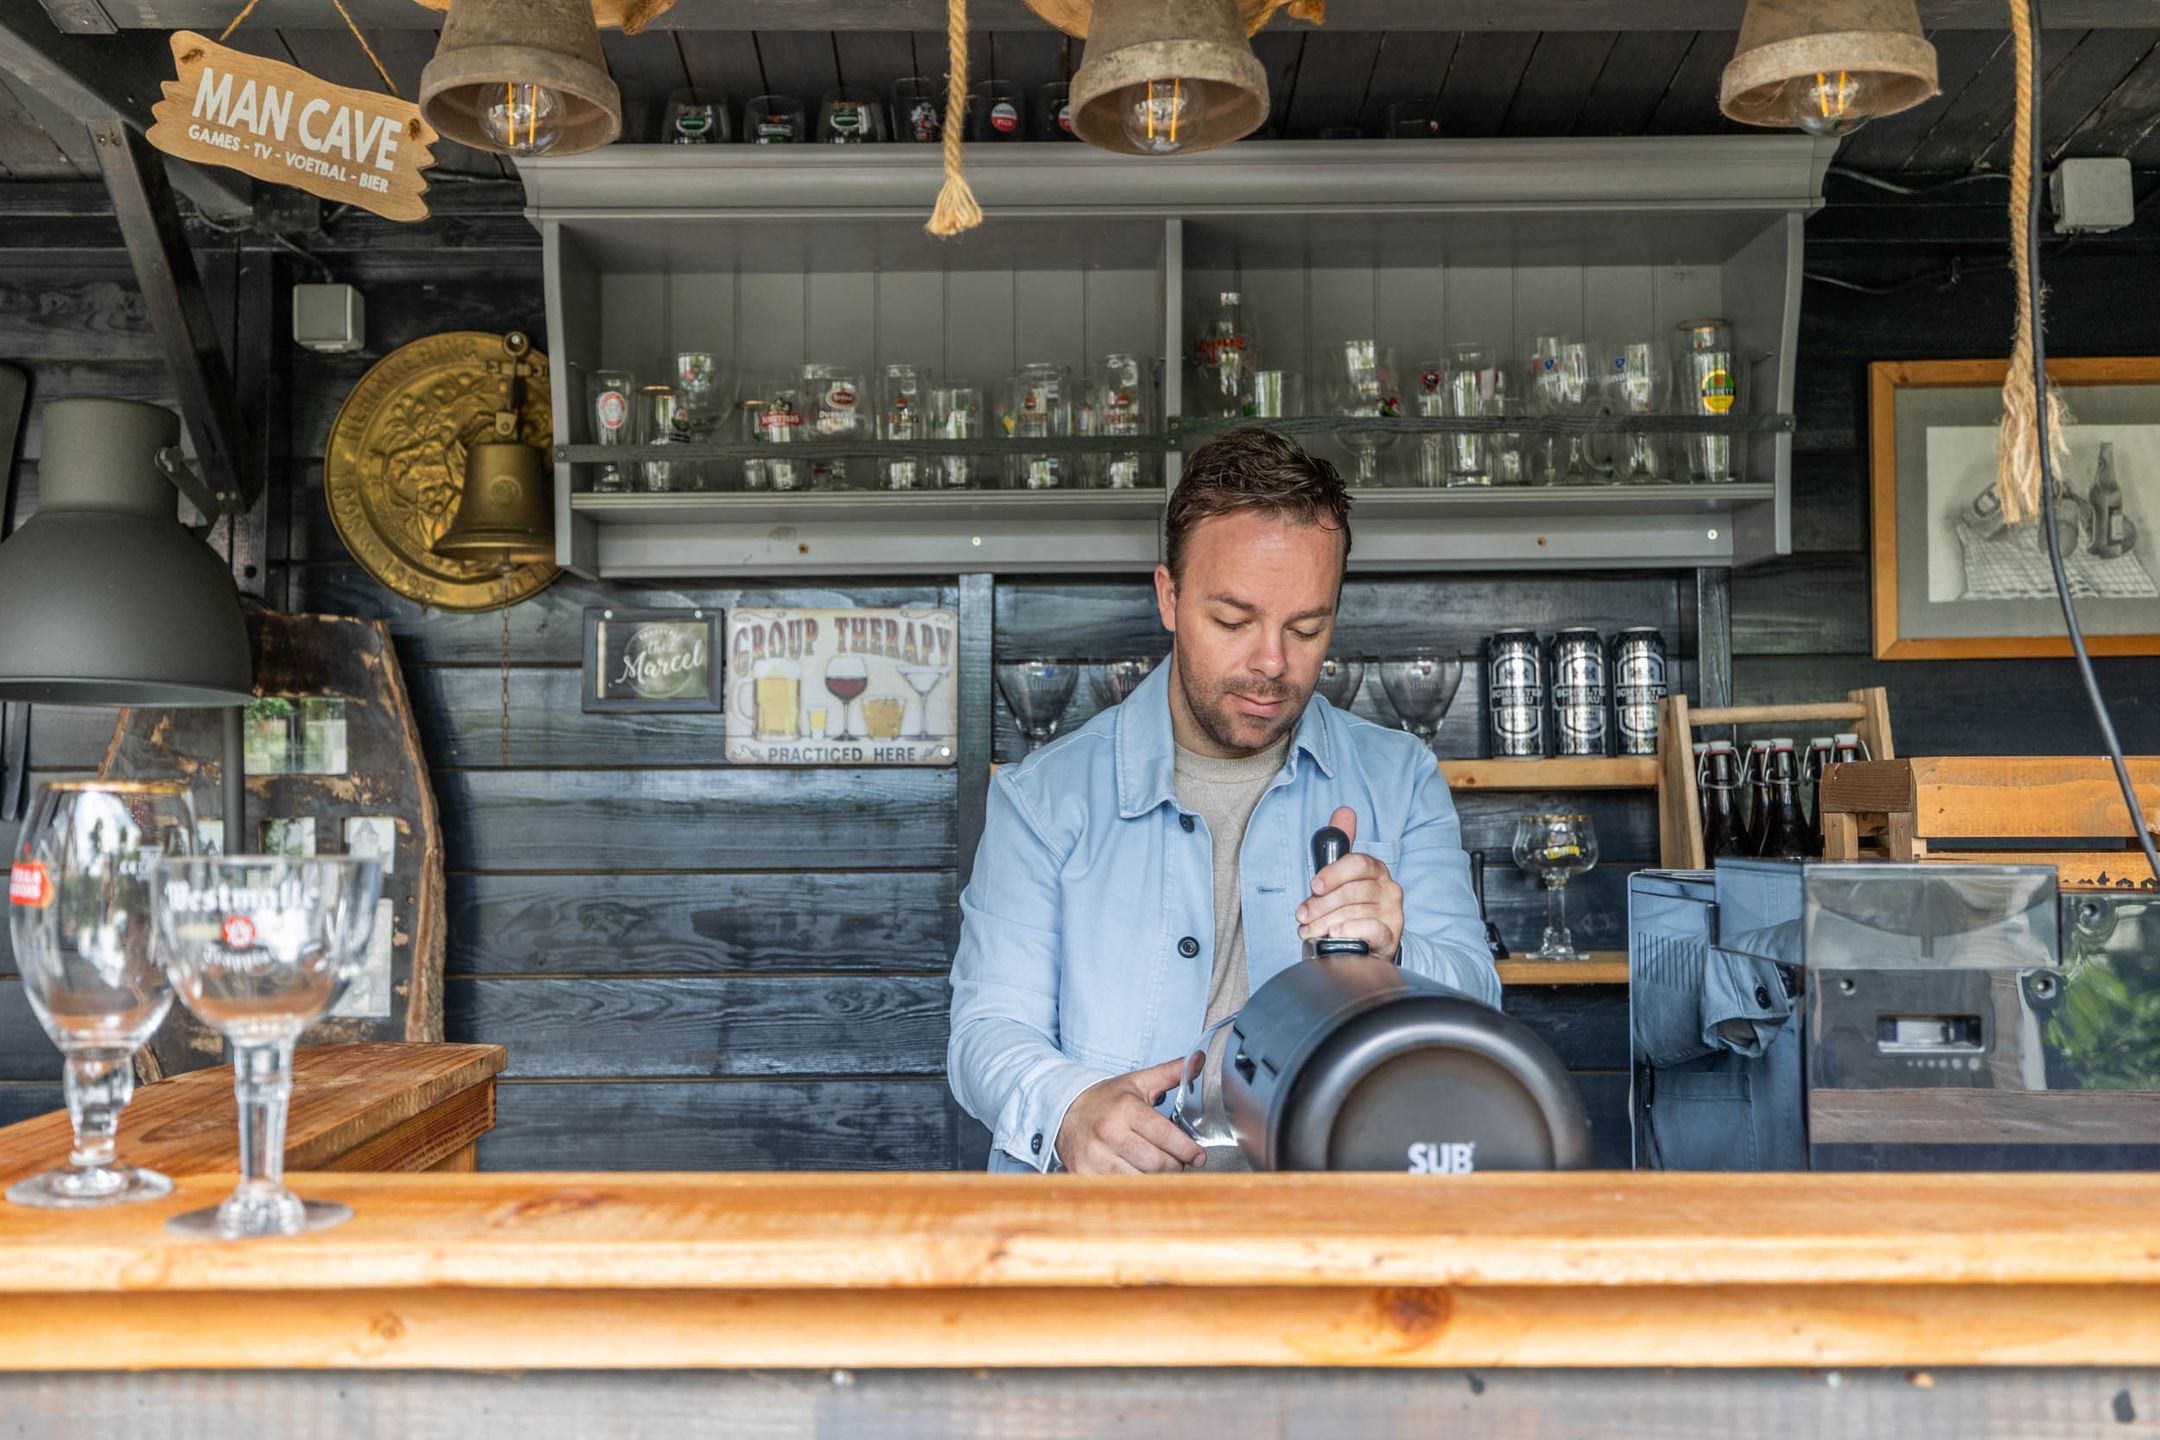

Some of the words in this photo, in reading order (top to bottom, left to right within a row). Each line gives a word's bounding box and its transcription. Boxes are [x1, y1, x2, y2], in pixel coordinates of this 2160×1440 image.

[192, 67, 294, 142] MAN
[299, 99, 403, 173] CAVE
[188, 124, 241, 152] GAMES
[253, 142, 273, 160] TV
[285, 151, 347, 182] VOETBAL
[359, 173, 389, 193] BIER
[615, 639, 704, 684] Marcel
[733, 617, 819, 678] GROUP
[834, 616, 952, 667] THERAPY
[768, 746, 863, 763] PRACTICED
[874, 746, 916, 763] HERE
[1407, 1141, 1473, 1174] SUB
